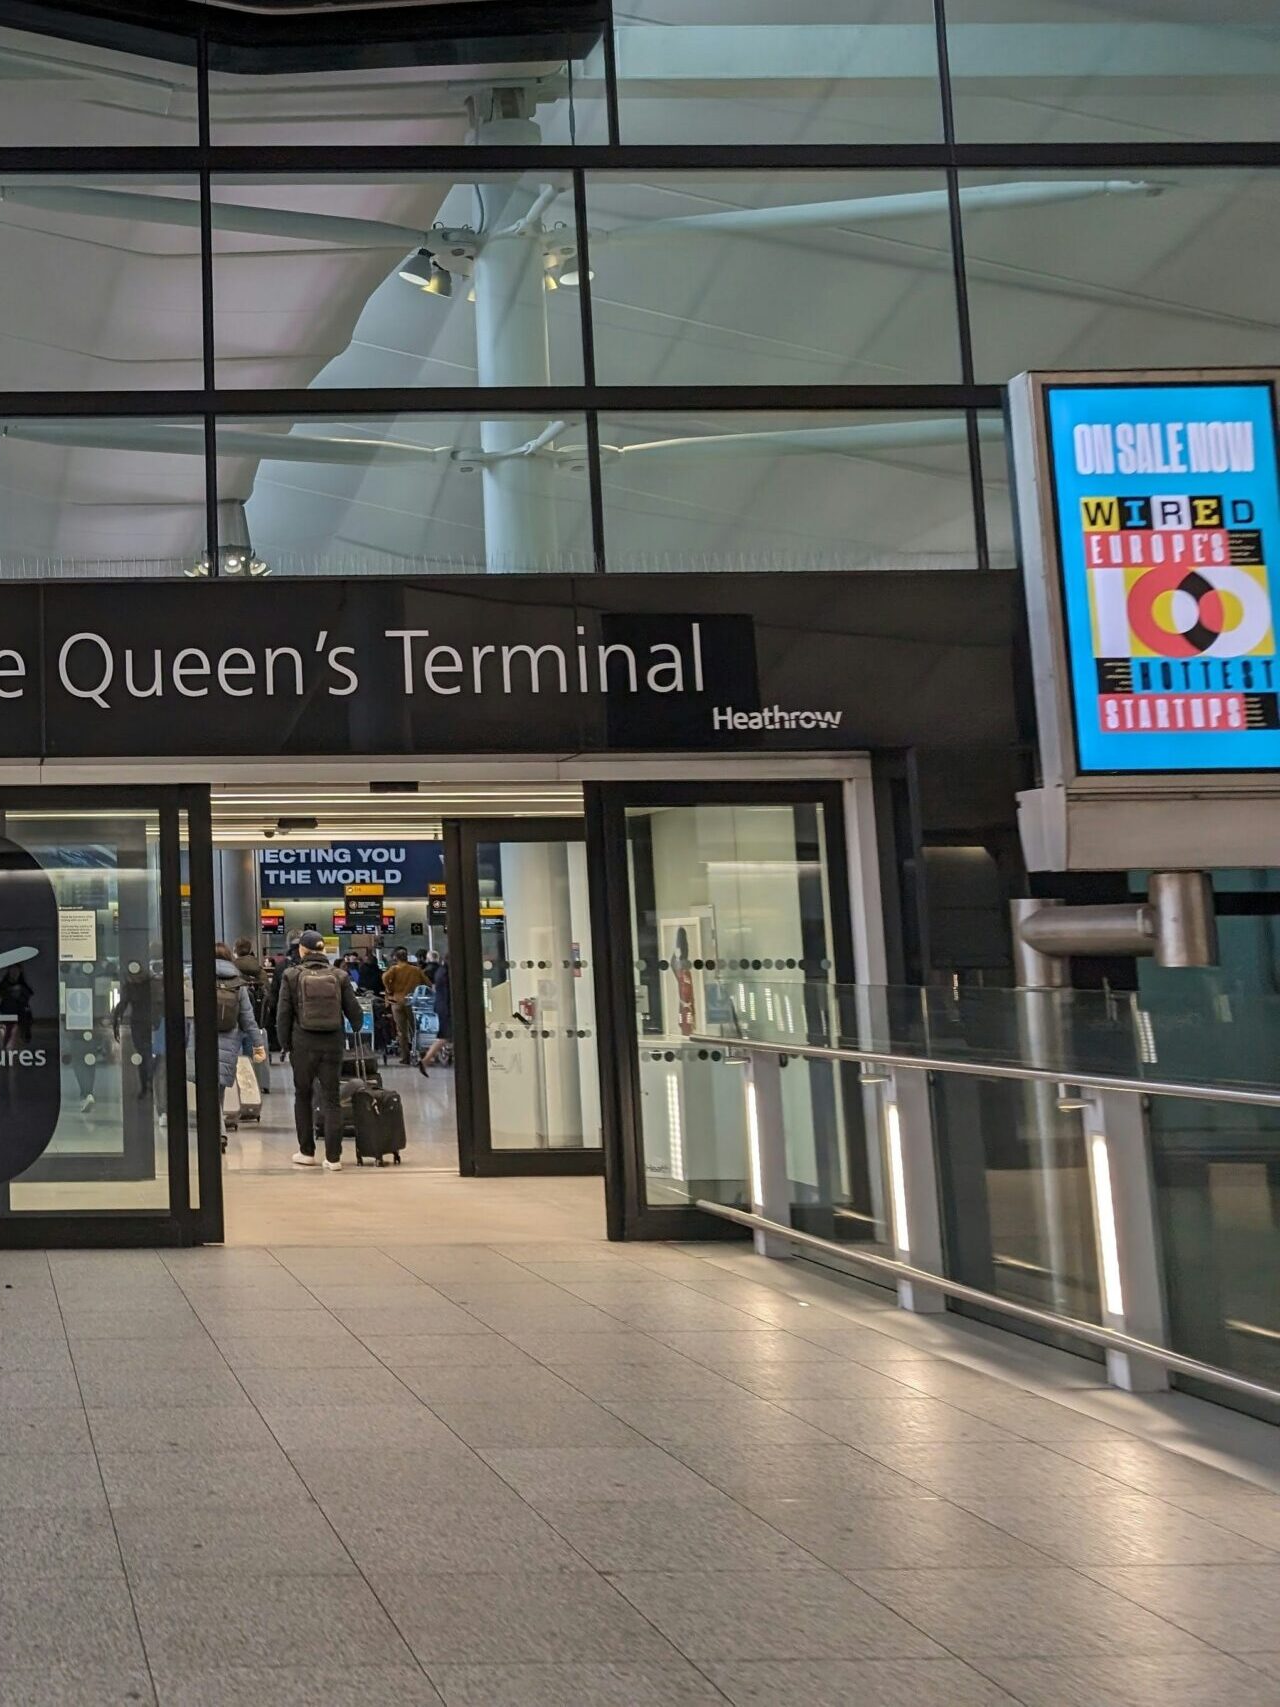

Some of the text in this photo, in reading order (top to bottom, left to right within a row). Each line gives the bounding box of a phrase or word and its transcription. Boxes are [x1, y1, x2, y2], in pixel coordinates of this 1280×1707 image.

[1073, 421, 1255, 475] ON SALE NOW
[1084, 499, 1255, 528] WIRED
[1090, 533, 1225, 565] EUROPE'S
[58, 630, 359, 709] Queen's
[385, 622, 704, 695] Terminal
[1140, 660, 1274, 691] HOTTEST
[713, 705, 843, 731] Heathrow
[1105, 697, 1241, 729] STARTUPS
[356, 848, 406, 863] YOU
[264, 869, 402, 884] THE WORLD
